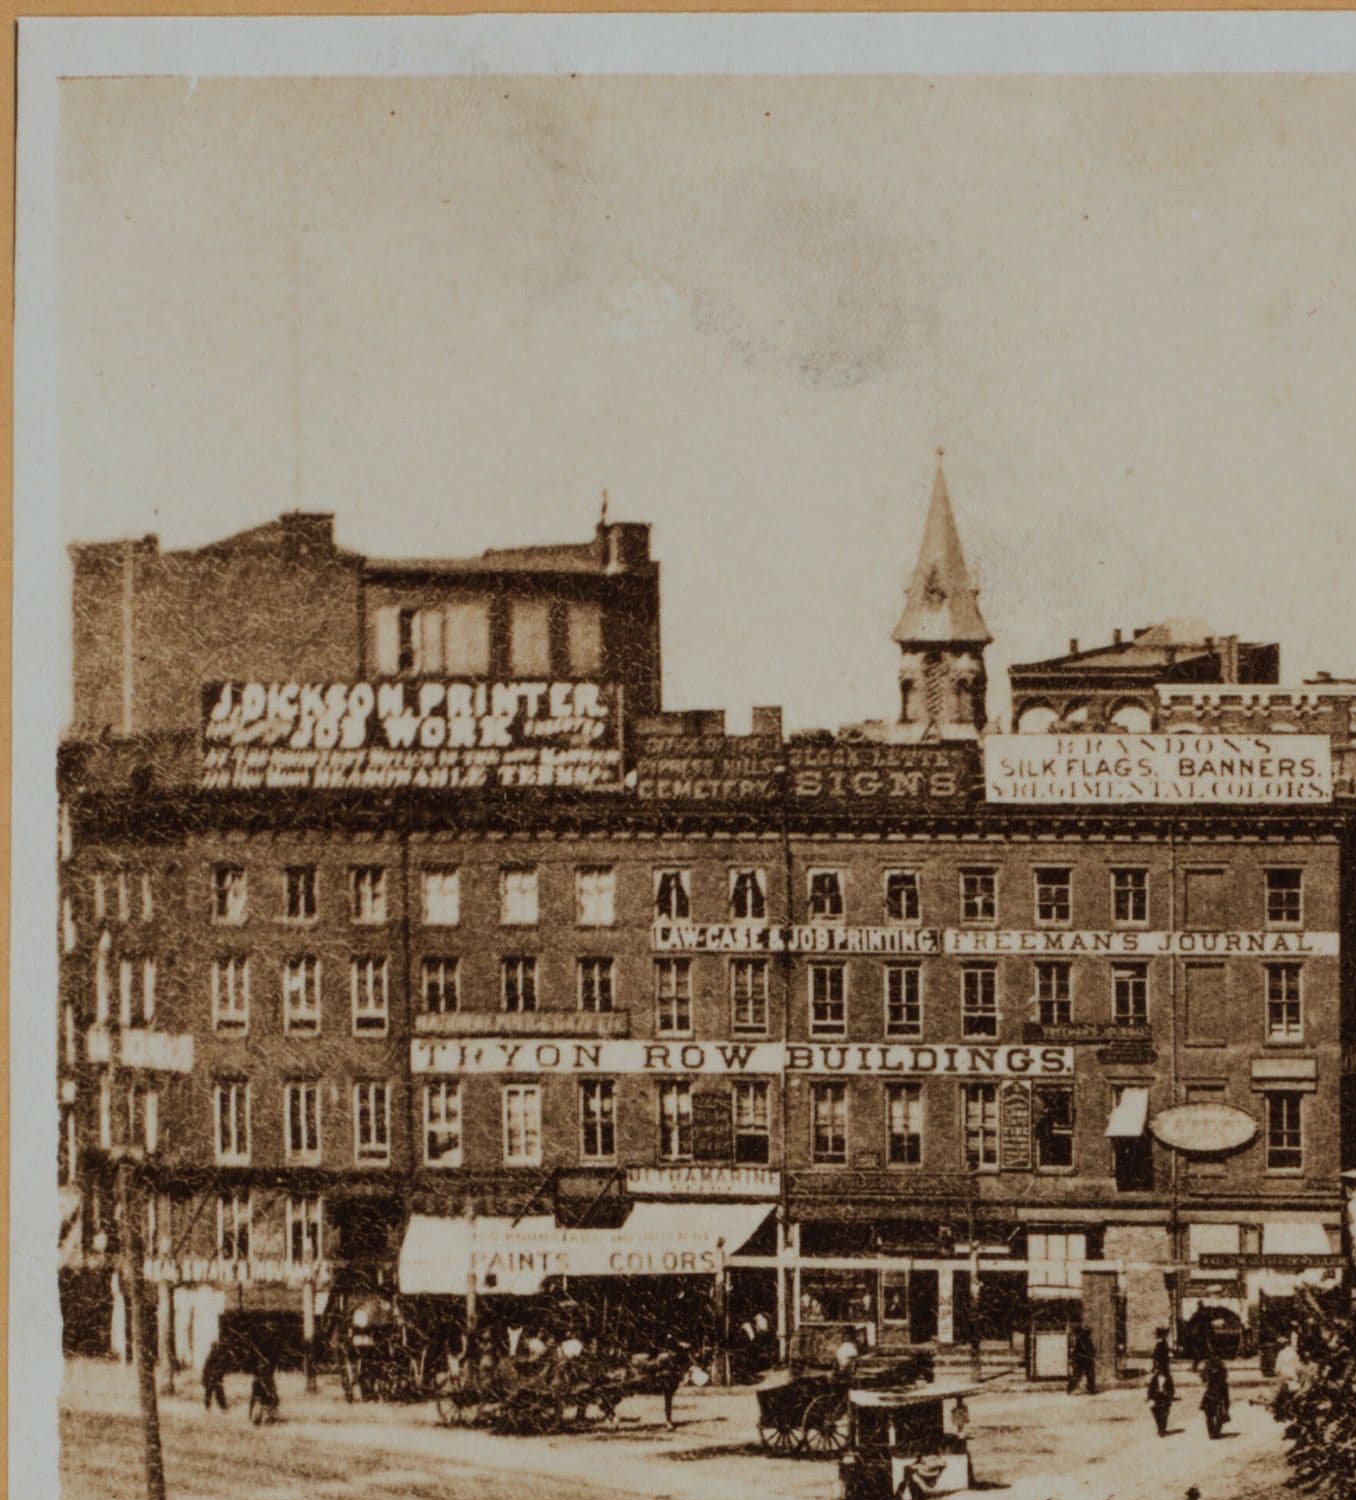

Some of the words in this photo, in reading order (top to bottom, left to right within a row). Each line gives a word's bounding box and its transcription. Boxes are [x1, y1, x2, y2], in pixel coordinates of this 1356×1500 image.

[386, 706, 513, 748] WORK
[1056, 738, 1272, 755] BRANDON'S
[1001, 757, 1057, 778] SILK
[1178, 757, 1323, 778] BANNERS.
[788, 926, 829, 951] JOB
[953, 933, 1139, 952] FREEMAN'S
[418, 1044, 603, 1069] TRYON
[643, 1044, 757, 1070] ROW
[785, 1046, 1073, 1073] BUILDINGS.
[608, 1250, 717, 1272] COLORS
